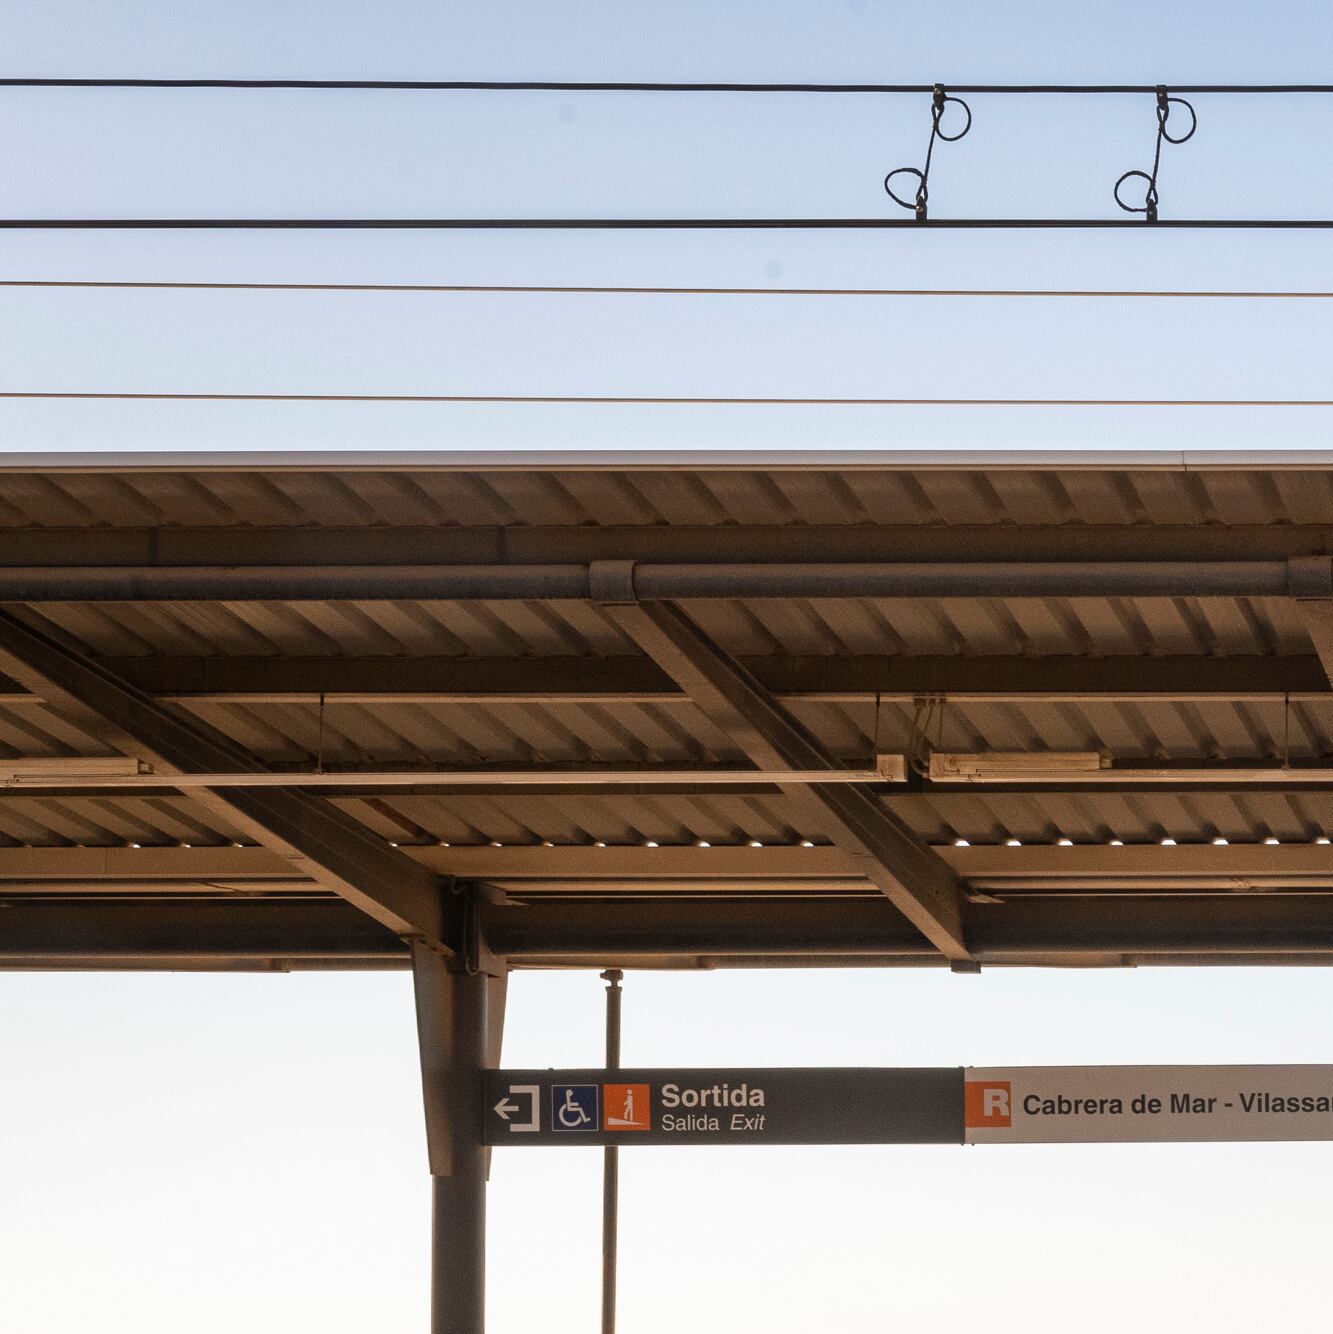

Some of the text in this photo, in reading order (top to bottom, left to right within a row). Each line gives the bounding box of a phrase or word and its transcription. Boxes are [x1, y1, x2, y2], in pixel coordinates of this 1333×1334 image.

[661, 1083, 765, 1108] Sortida
[983, 1088, 1010, 1117] R
[1023, 1094, 1123, 1116] Cabrera
[1130, 1093, 1162, 1115] de
[1170, 1093, 1217, 1114] Mar
[661, 1113, 766, 1132] Salida Exit
